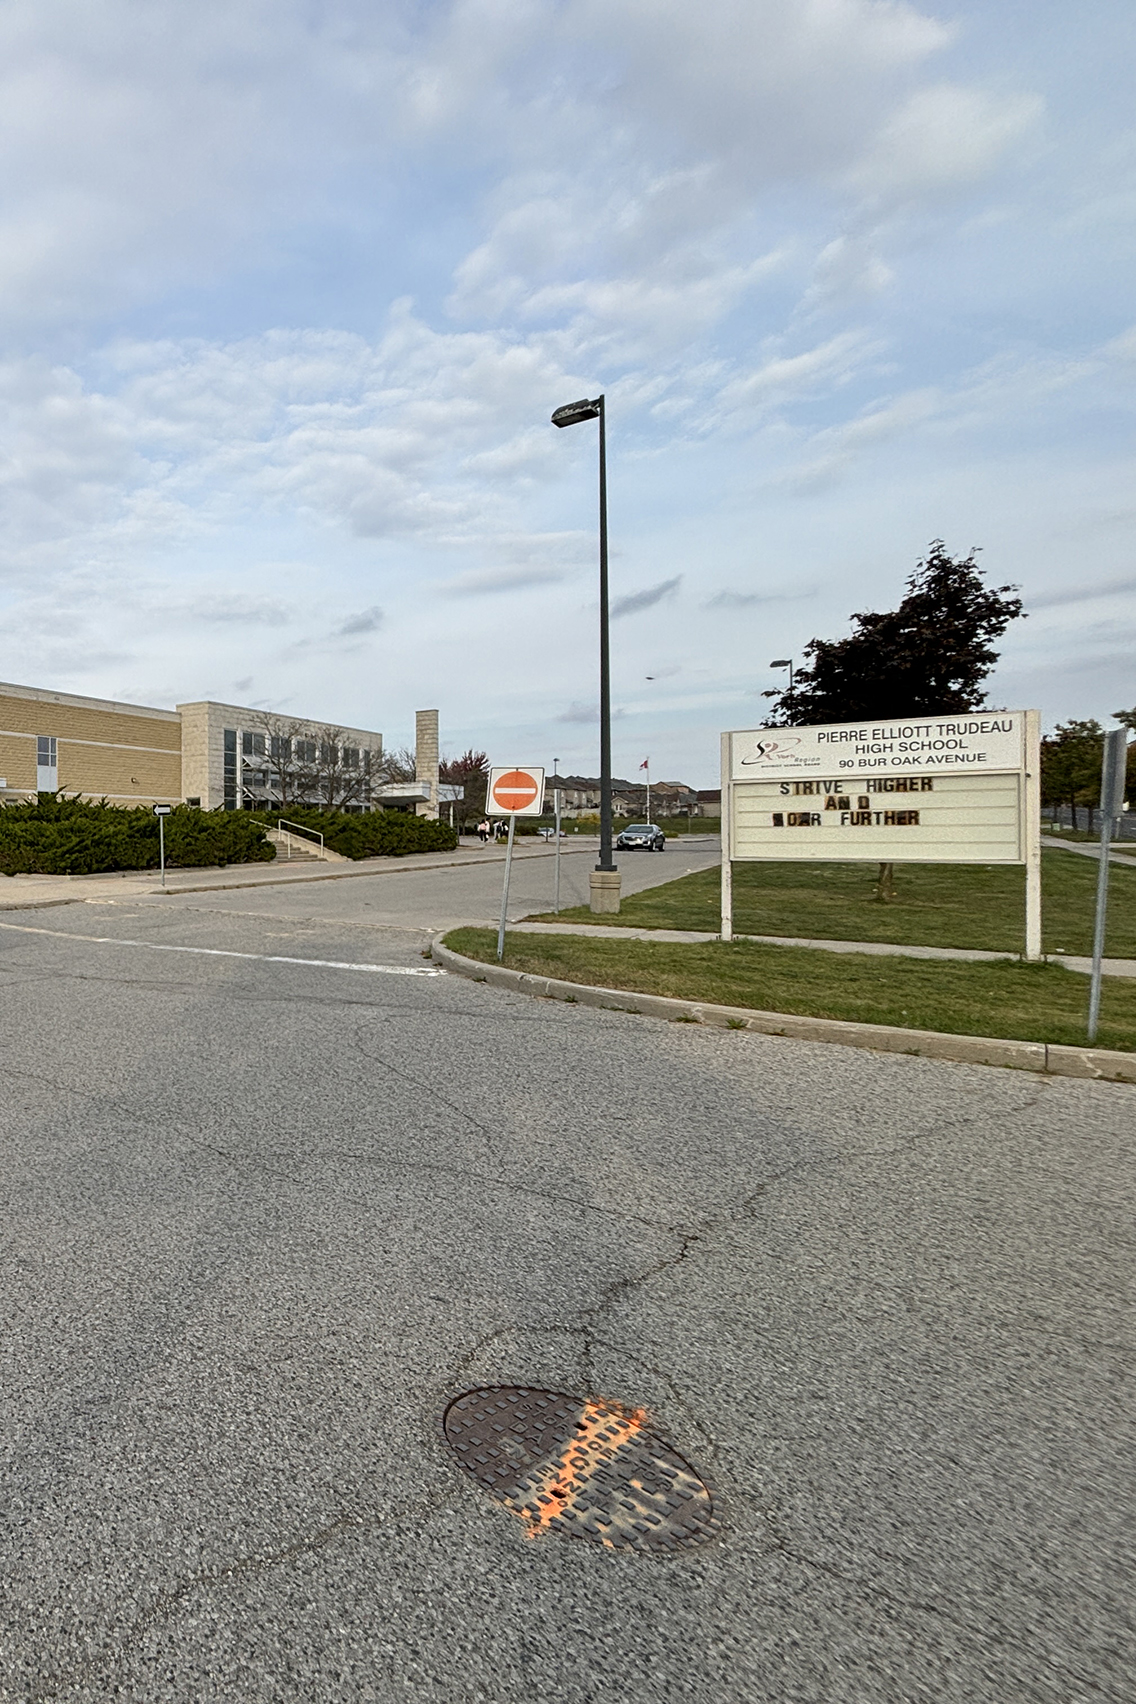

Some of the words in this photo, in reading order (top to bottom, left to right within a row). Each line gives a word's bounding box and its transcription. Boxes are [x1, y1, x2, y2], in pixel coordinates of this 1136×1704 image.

[817, 730, 868, 744] PIERRE
[872, 725, 932, 740] ELLIOTT
[936, 719, 1013, 737] TRUDEAU
[855, 743, 893, 755] HIGH
[898, 739, 969, 753] SCHOOL
[794, 756, 821, 764] Region
[839, 759, 855, 769] 90
[858, 757, 887, 768] BUR
[891, 755, 922, 767] OAK
[925, 752, 987, 765] AVENUE
[780, 780, 843, 795] STRIVE
[866, 777, 933, 793] HIGHER
